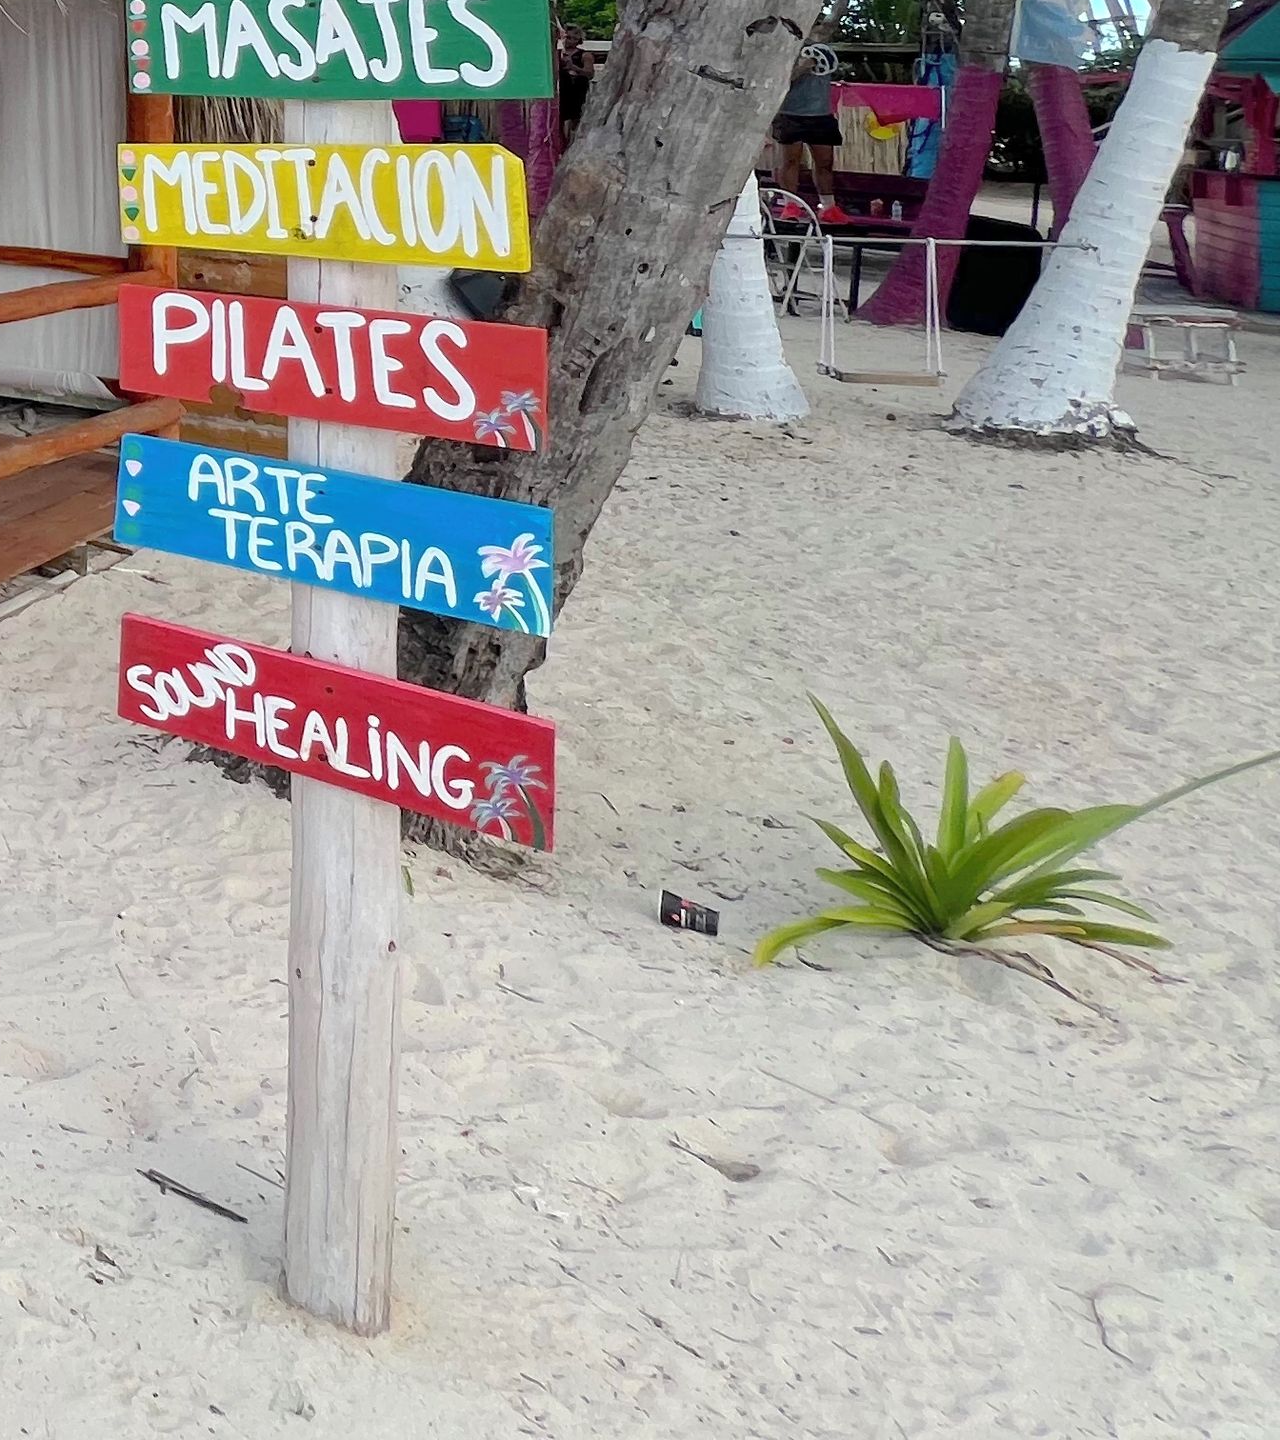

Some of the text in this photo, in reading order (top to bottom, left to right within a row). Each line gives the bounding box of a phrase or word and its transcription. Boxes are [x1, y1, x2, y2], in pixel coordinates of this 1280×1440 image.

[142, 148, 510, 257] MEDITACION
[152, 292, 477, 422] PILATES
[188, 454, 334, 523] ARTE
[208, 508, 457, 608] TERAPIA
[126, 643, 257, 722] SOUND
